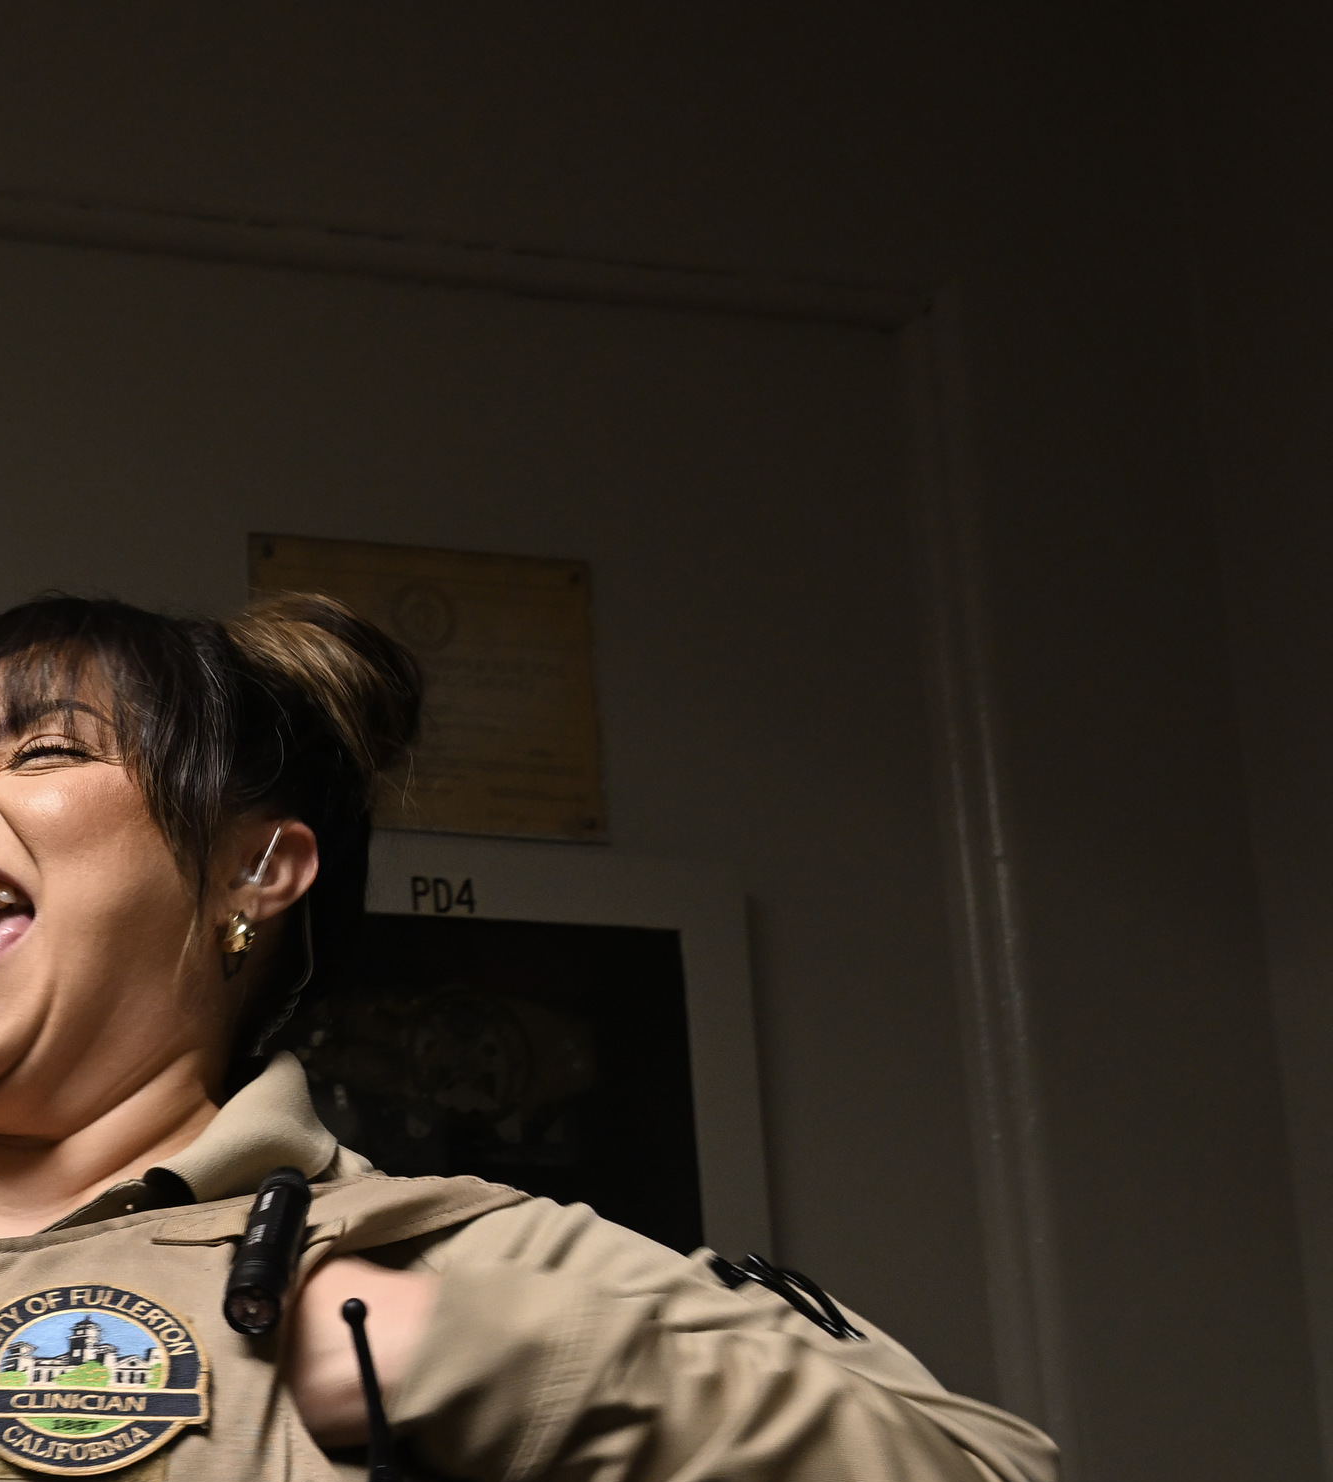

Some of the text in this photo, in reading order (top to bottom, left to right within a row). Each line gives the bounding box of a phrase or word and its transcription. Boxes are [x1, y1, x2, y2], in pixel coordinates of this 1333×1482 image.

[410, 875, 476, 914] PD4
[24, 1290, 64, 1315] OF
[69, 1288, 195, 1356] FULLERTON
[10, 1392, 147, 1413] CLINICIAN
[1, 1425, 152, 1462] CALIFORNIA
